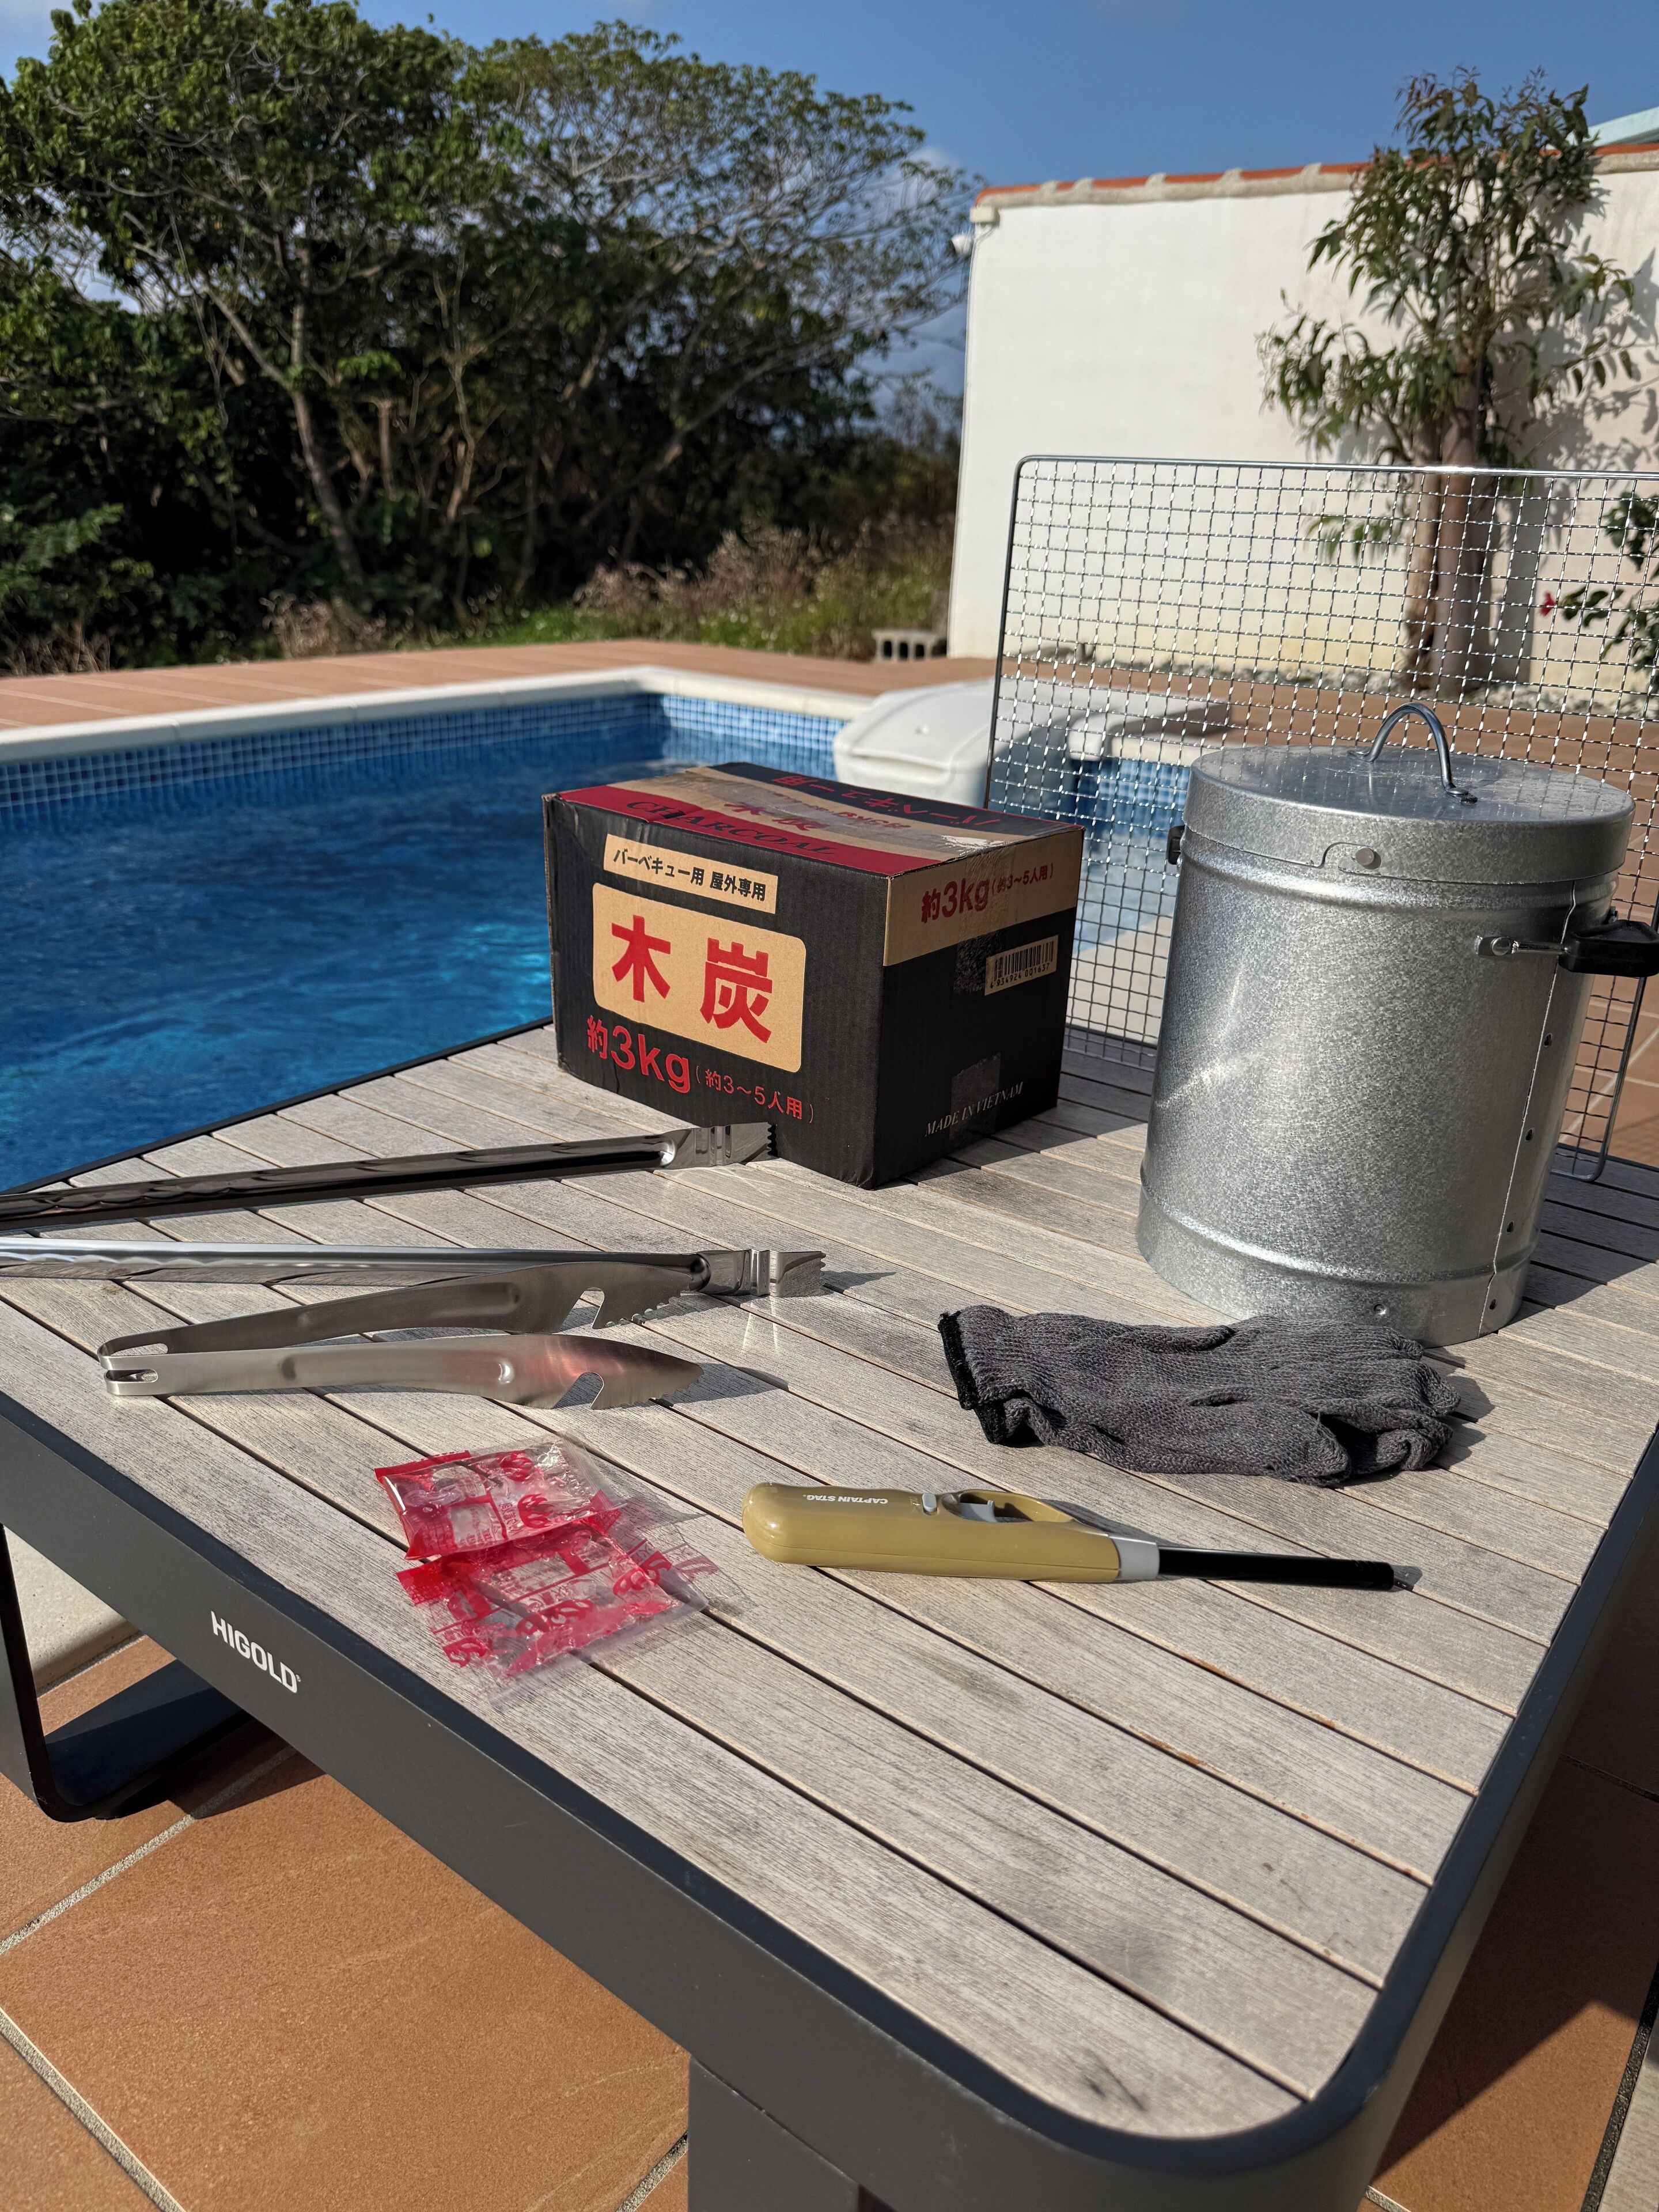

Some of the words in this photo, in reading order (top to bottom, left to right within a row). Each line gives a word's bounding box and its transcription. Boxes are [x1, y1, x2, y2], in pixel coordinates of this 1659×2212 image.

[626, 801, 836, 854] CHARCOAL
[613, 849, 704, 886] バーベキュー用
[710, 871, 766, 902] 屋外専用
[997, 974, 1022, 987] 934924
[1025, 962, 1050, 978] 001637
[587, 1015, 691, 1093] 約3kg
[925, 1110, 960, 1137] MADE
[961, 1104, 975, 1120] IN
[976, 1081, 1024, 1113] VIETNAM
[838, 1496, 888, 1505] CAPTAIN
[211, 1611, 297, 1694] HIGOLD
